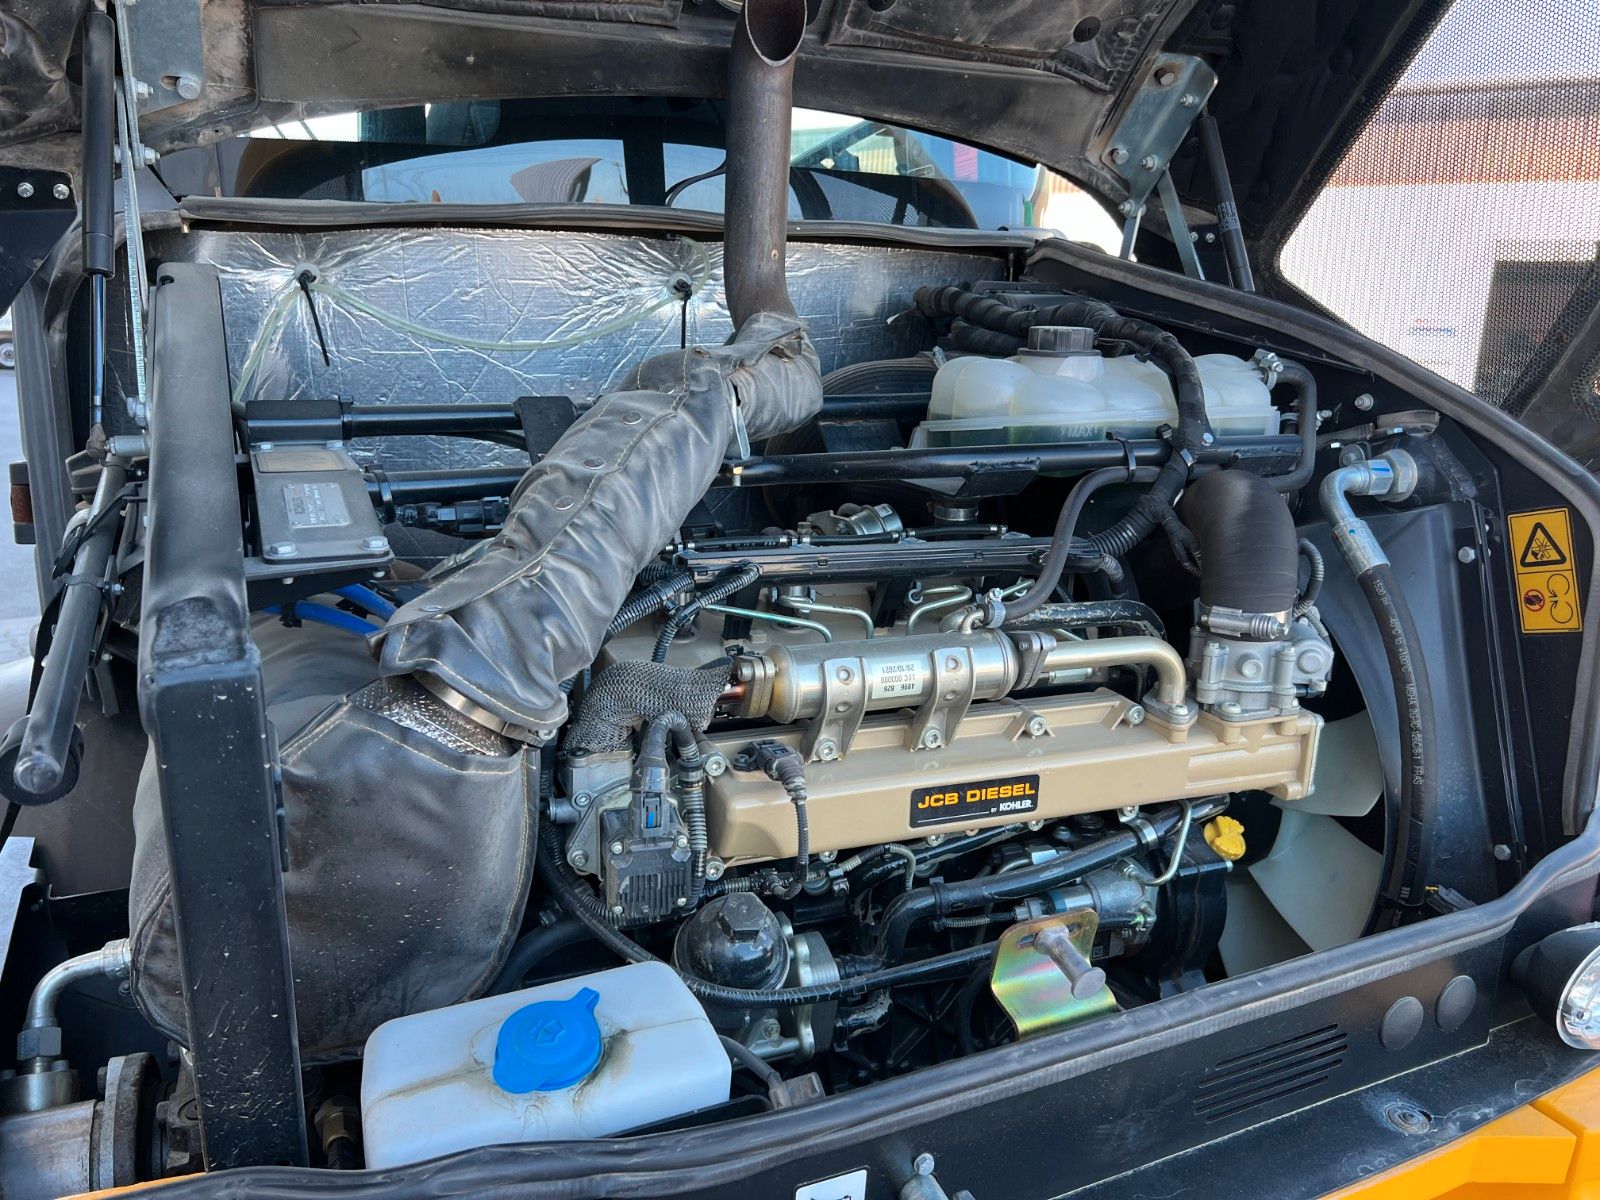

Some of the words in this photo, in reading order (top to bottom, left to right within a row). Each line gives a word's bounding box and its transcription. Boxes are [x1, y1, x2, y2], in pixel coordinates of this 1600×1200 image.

[1373, 579, 1386, 596] 1520
[1405, 683, 1417, 706] MSHA
[1412, 765, 1424, 785] FRAS
[917, 792, 959, 809] JCB
[966, 782, 1036, 803] DIESEL
